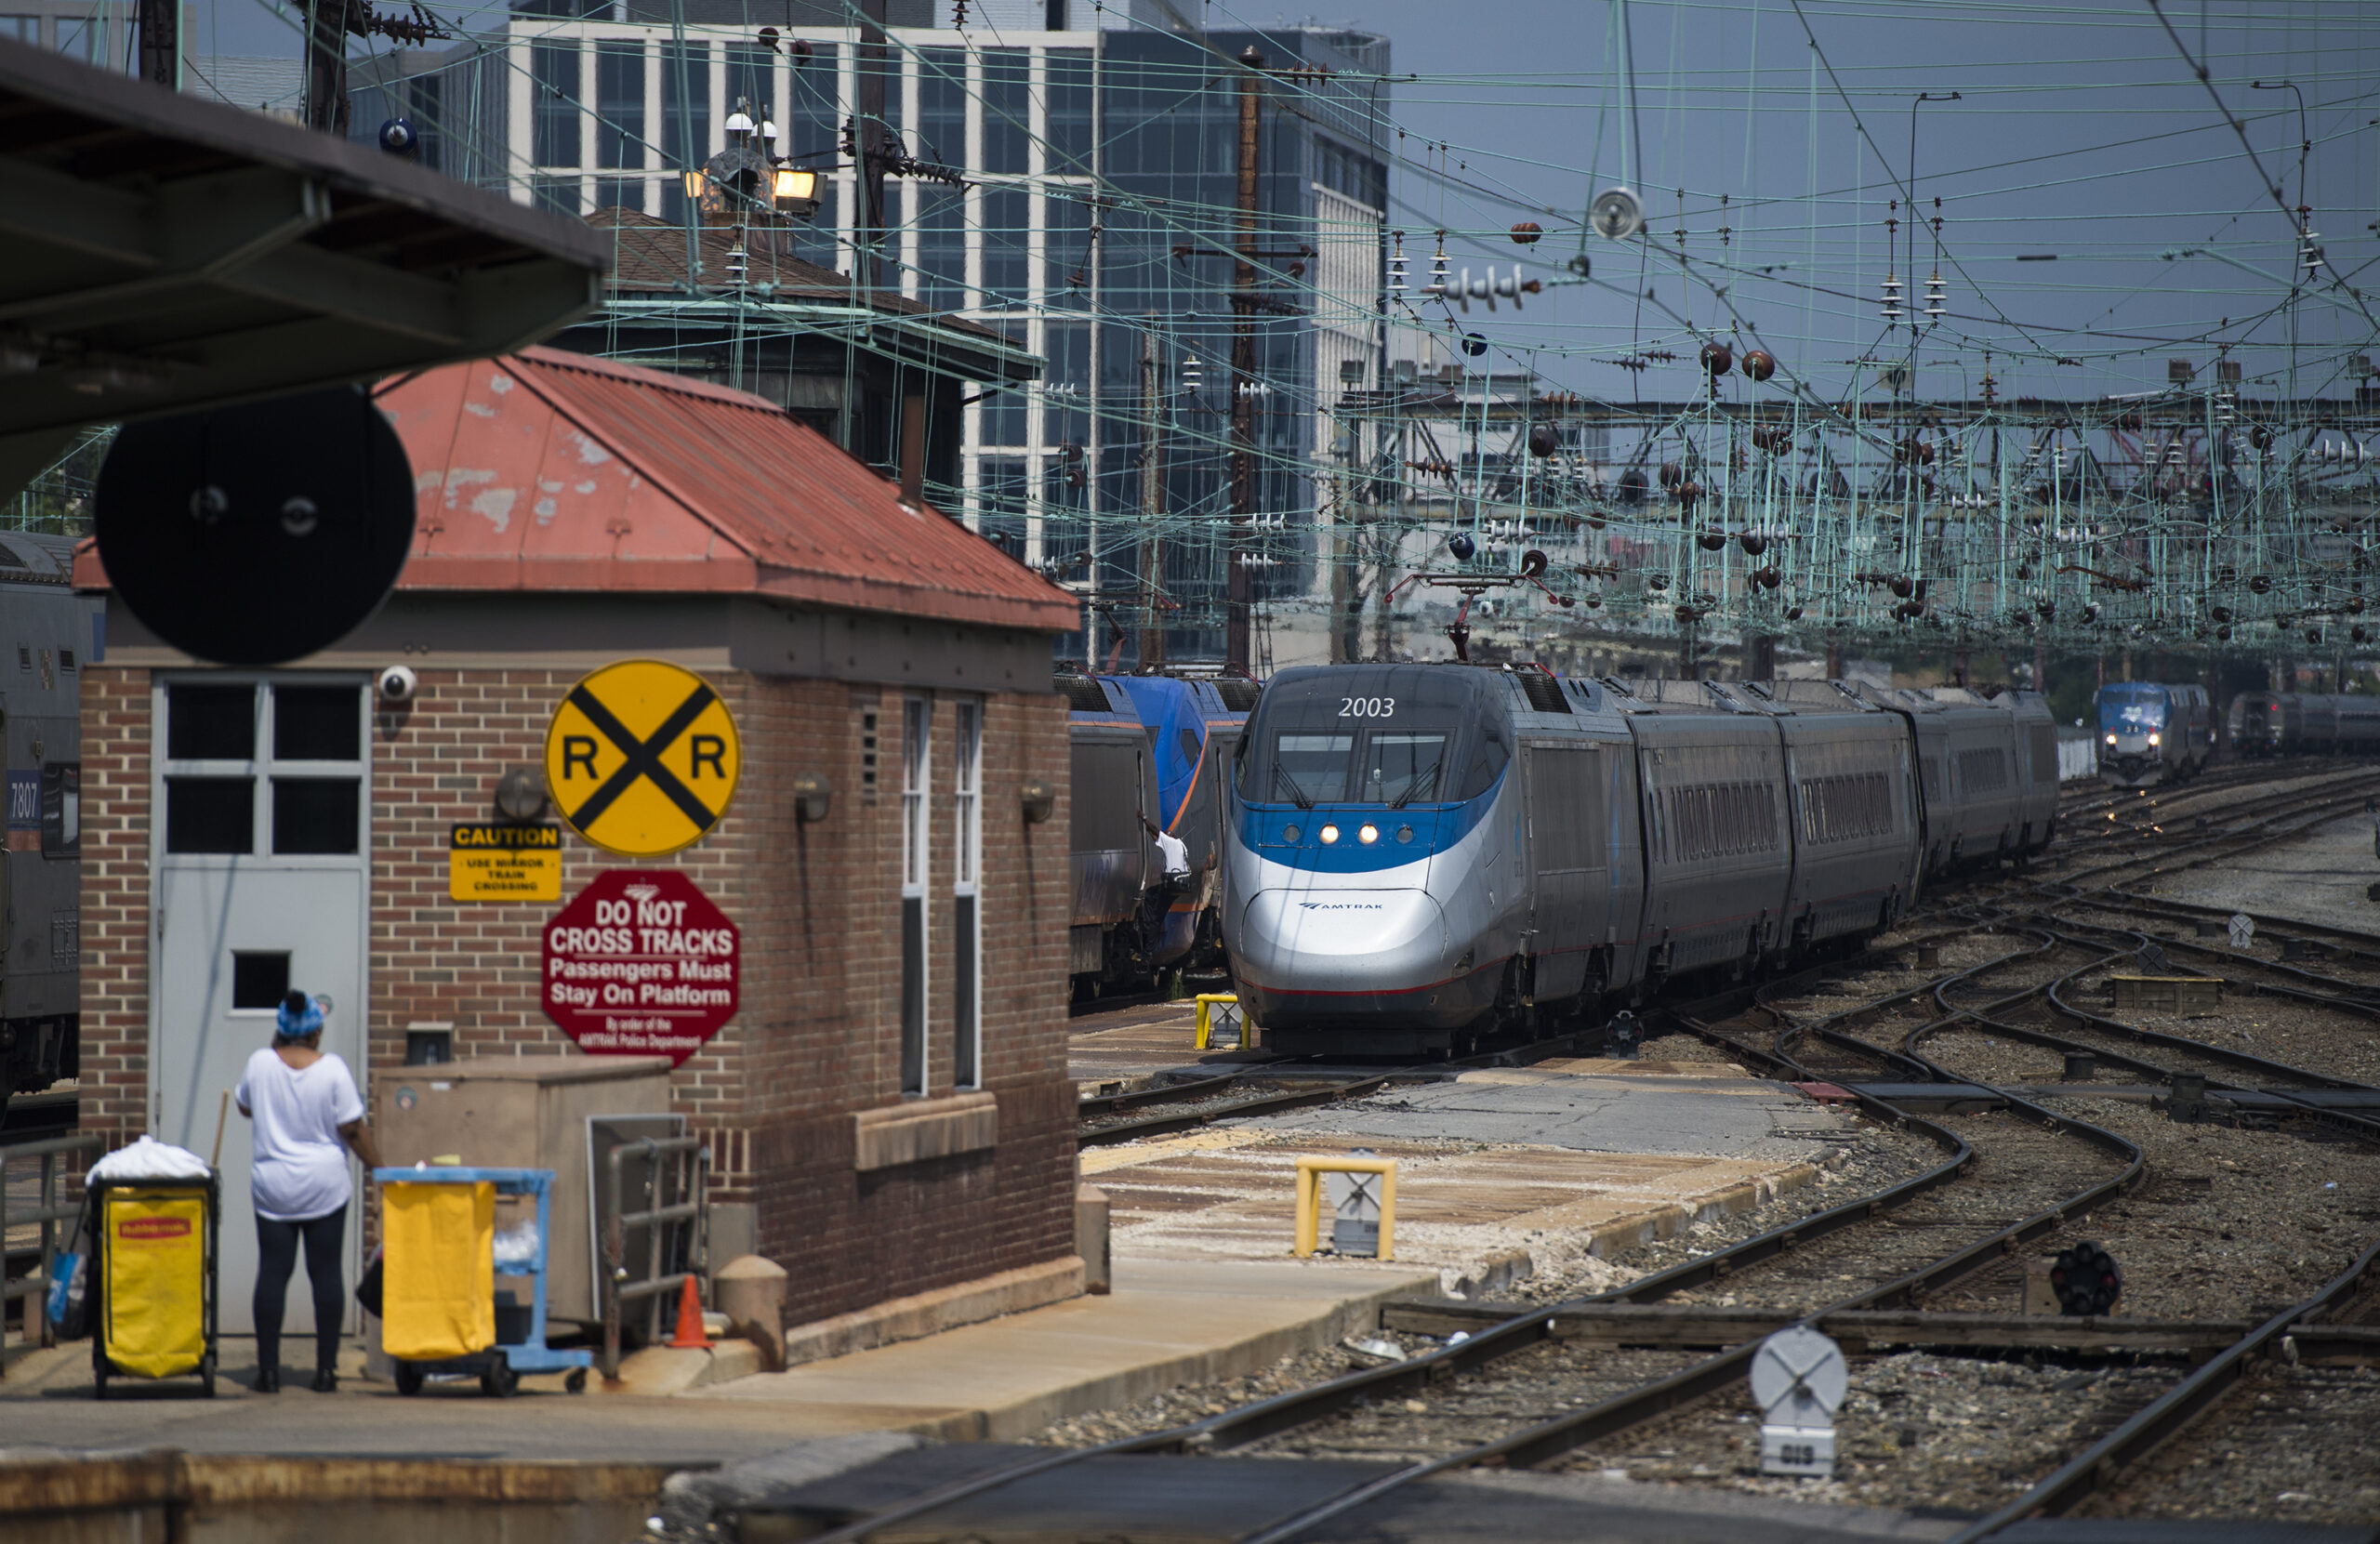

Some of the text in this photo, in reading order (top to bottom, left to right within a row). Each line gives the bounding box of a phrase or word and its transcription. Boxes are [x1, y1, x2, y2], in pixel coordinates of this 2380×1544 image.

[1339, 697, 1395, 717] 2003
[562, 734, 600, 780] R
[691, 734, 727, 780] R
[12, 782, 37, 818] 7807
[455, 827, 558, 846] CAUTION
[467, 858, 492, 867] USE
[473, 881, 538, 891] CROSSING
[488, 870, 525, 879] TRAIN
[596, 899, 687, 927] DO NOT
[549, 927, 734, 956] CROSS TRACKS
[549, 957, 732, 983] Passengers Must
[550, 982, 732, 1008] Stay On Platform
[648, 1034, 702, 1051] Department
